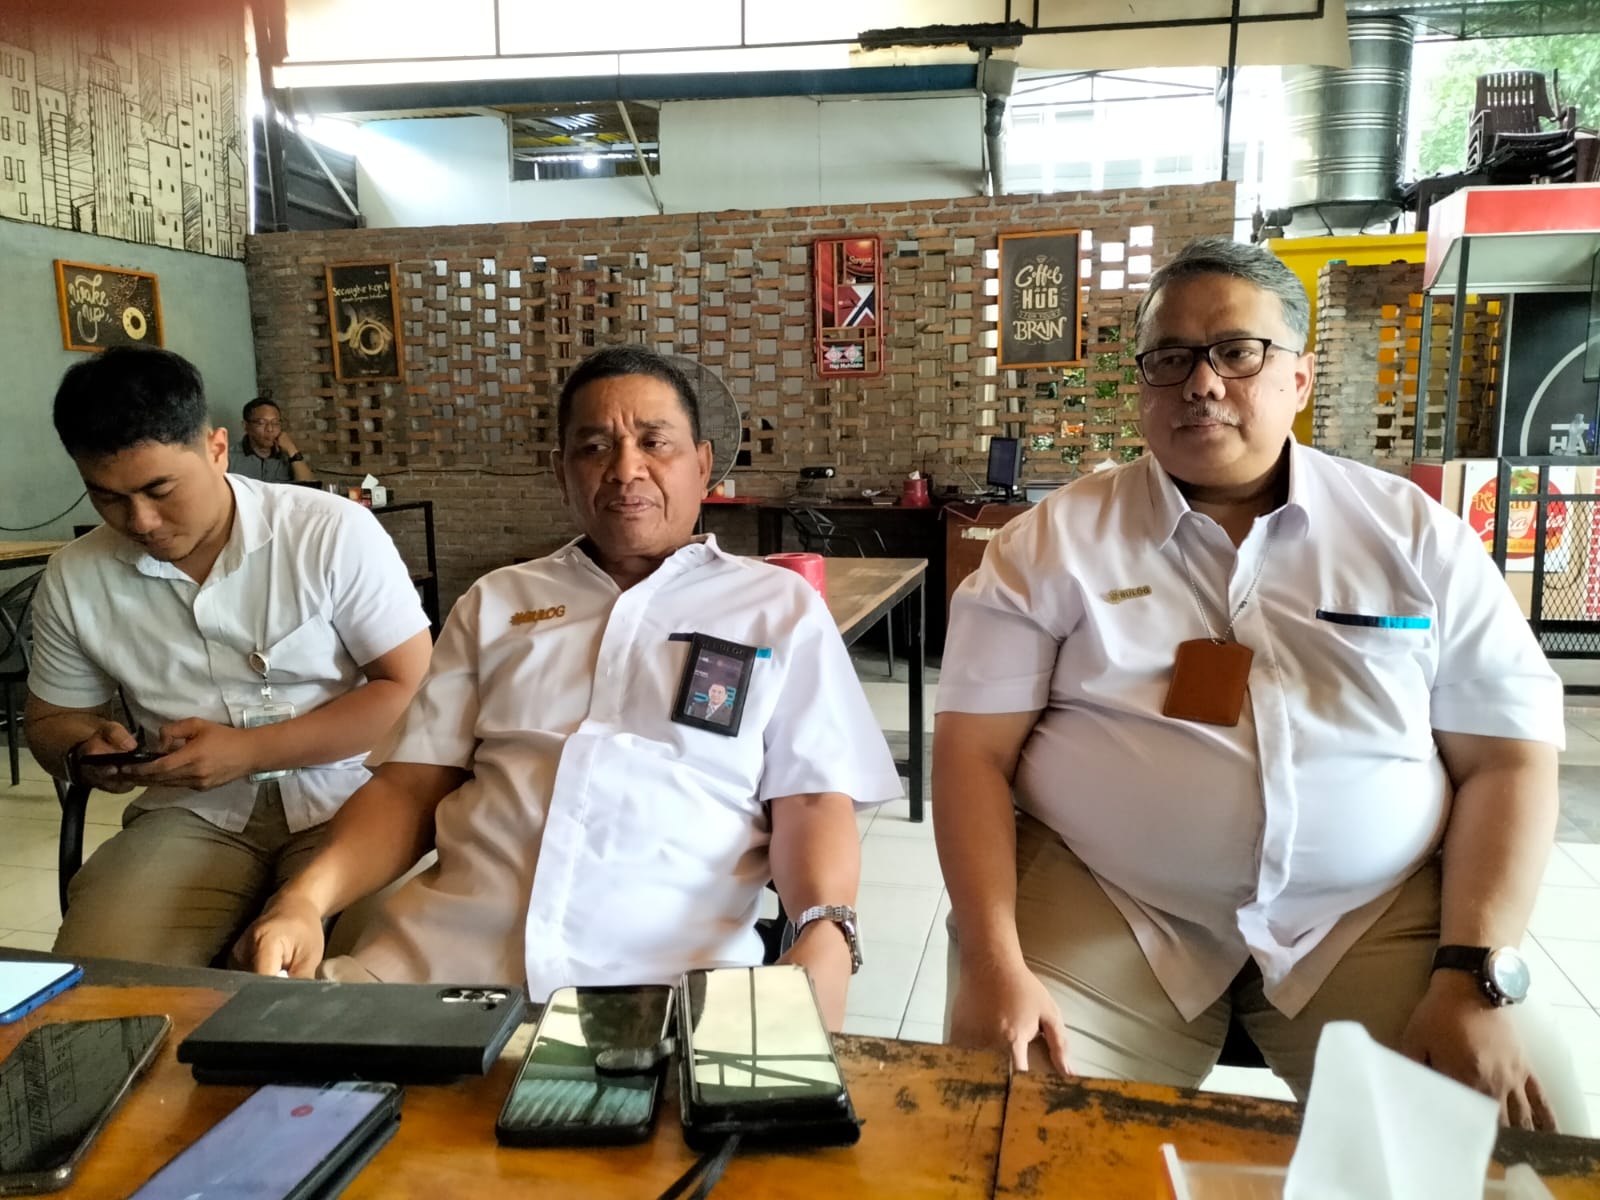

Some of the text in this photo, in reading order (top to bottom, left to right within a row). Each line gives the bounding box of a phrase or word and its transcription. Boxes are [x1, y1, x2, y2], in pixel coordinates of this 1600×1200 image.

[1015, 264, 1063, 288] Coffee
[1012, 316, 1068, 341] BRAIN
[1120, 585, 1151, 599] BULOG
